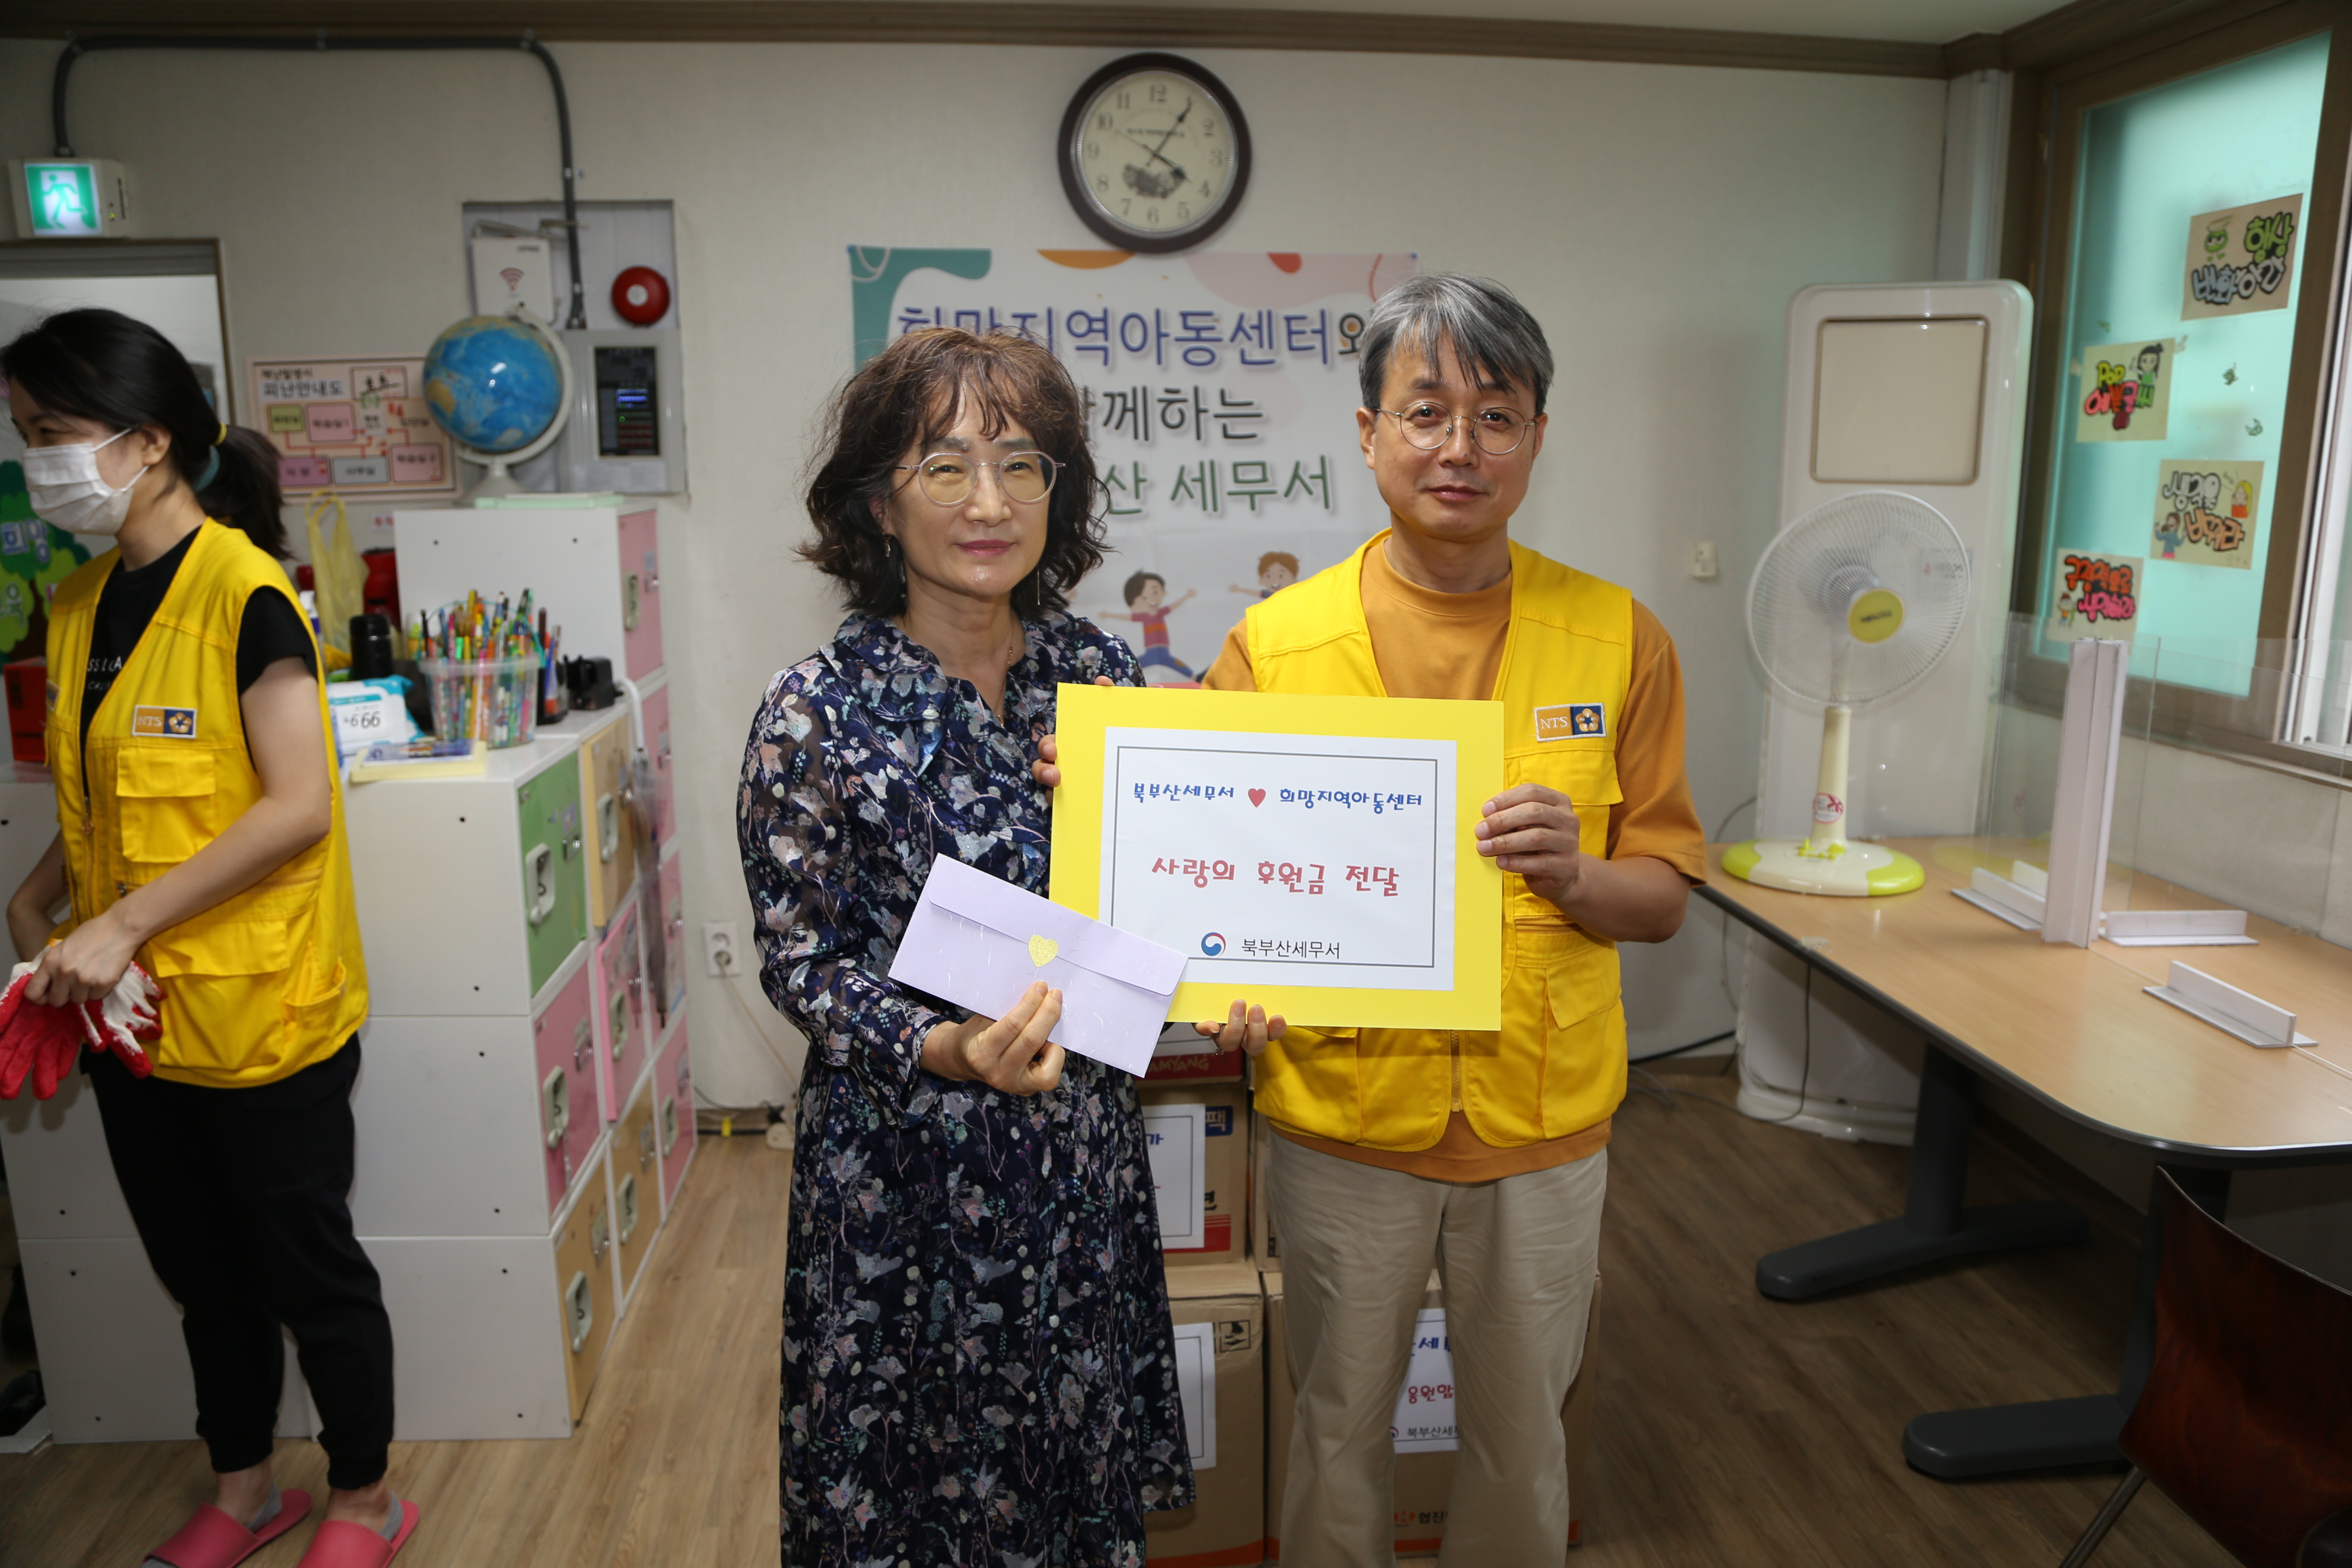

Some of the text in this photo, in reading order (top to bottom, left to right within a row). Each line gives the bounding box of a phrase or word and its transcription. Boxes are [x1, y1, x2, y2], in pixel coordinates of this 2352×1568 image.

[1118, 91, 1130, 109] 11
[1149, 84, 1167, 102] 12
[1098, 112, 1113, 130] 10
[1204, 117, 1215, 137] 2
[1087, 141, 1100, 159] 9
[1210, 148, 1223, 167] 3
[1097, 174, 1109, 192] 8
[1200, 180, 1210, 197] 4
[1120, 198, 1132, 216] 7
[1147, 206, 1160, 225] 6
[1178, 201, 1190, 220] 5
[1170, 454, 1331, 513] 세무서
[137, 715, 162, 727] NTS
[1540, 716, 1569, 730] NTS
[1133, 782, 1422, 815] 북부산세무서 희망지역아동센터
[1151, 857, 1400, 897] 사랑의 후원금 전달
[1241, 938, 1340, 960] 북부산세무서
[1148, 1054, 1210, 1072] AMYANG
[1418, 1510, 1448, 1525] 협진
